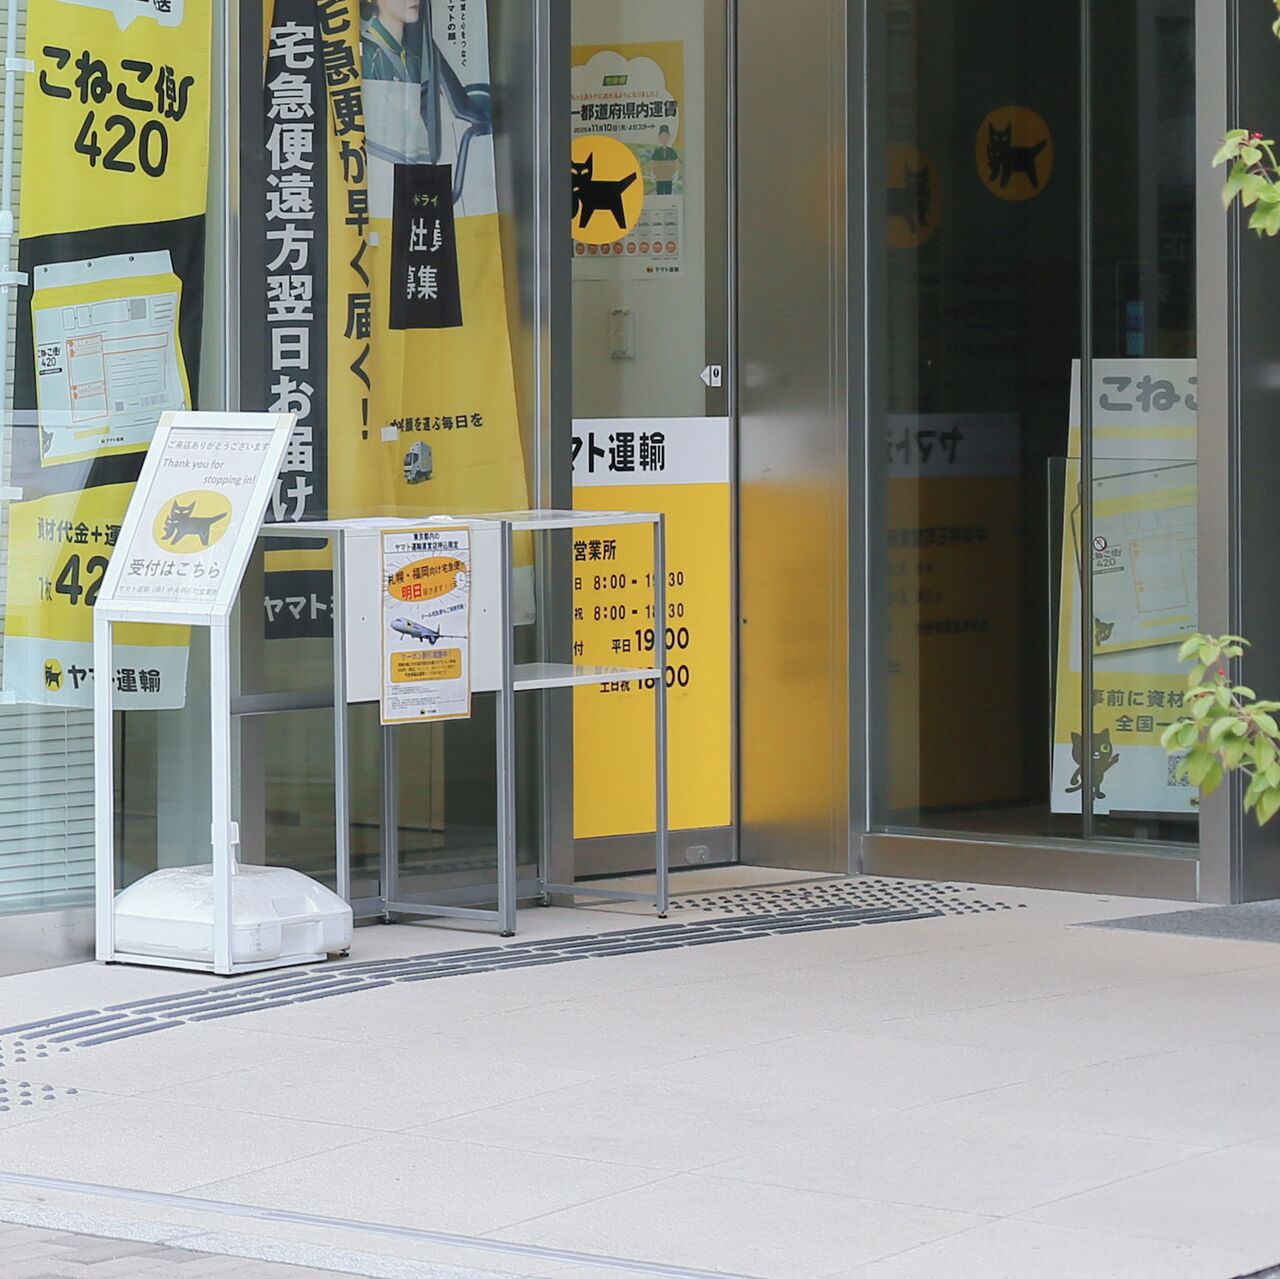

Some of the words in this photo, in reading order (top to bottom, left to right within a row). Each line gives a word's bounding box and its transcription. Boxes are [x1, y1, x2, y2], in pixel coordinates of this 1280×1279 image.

[40, 46, 194, 121] こねこ便
[75, 111, 168, 177] 420
[162, 458, 190, 469] Thank
[191, 461, 209, 471] you
[209, 459, 224, 470] for
[202, 475, 241, 487] stopping
[243, 475, 256, 485] in!
[574, 539, 617, 561] 営業所
[127, 558, 221, 579] 受付はこちら
[593, 574, 627, 590] 8:00
[264, 595, 335, 622] ヤマト
[593, 605, 627, 621] 8:00
[611, 639, 631, 654] 平日
[68, 665, 160, 693] ヤ運輸
